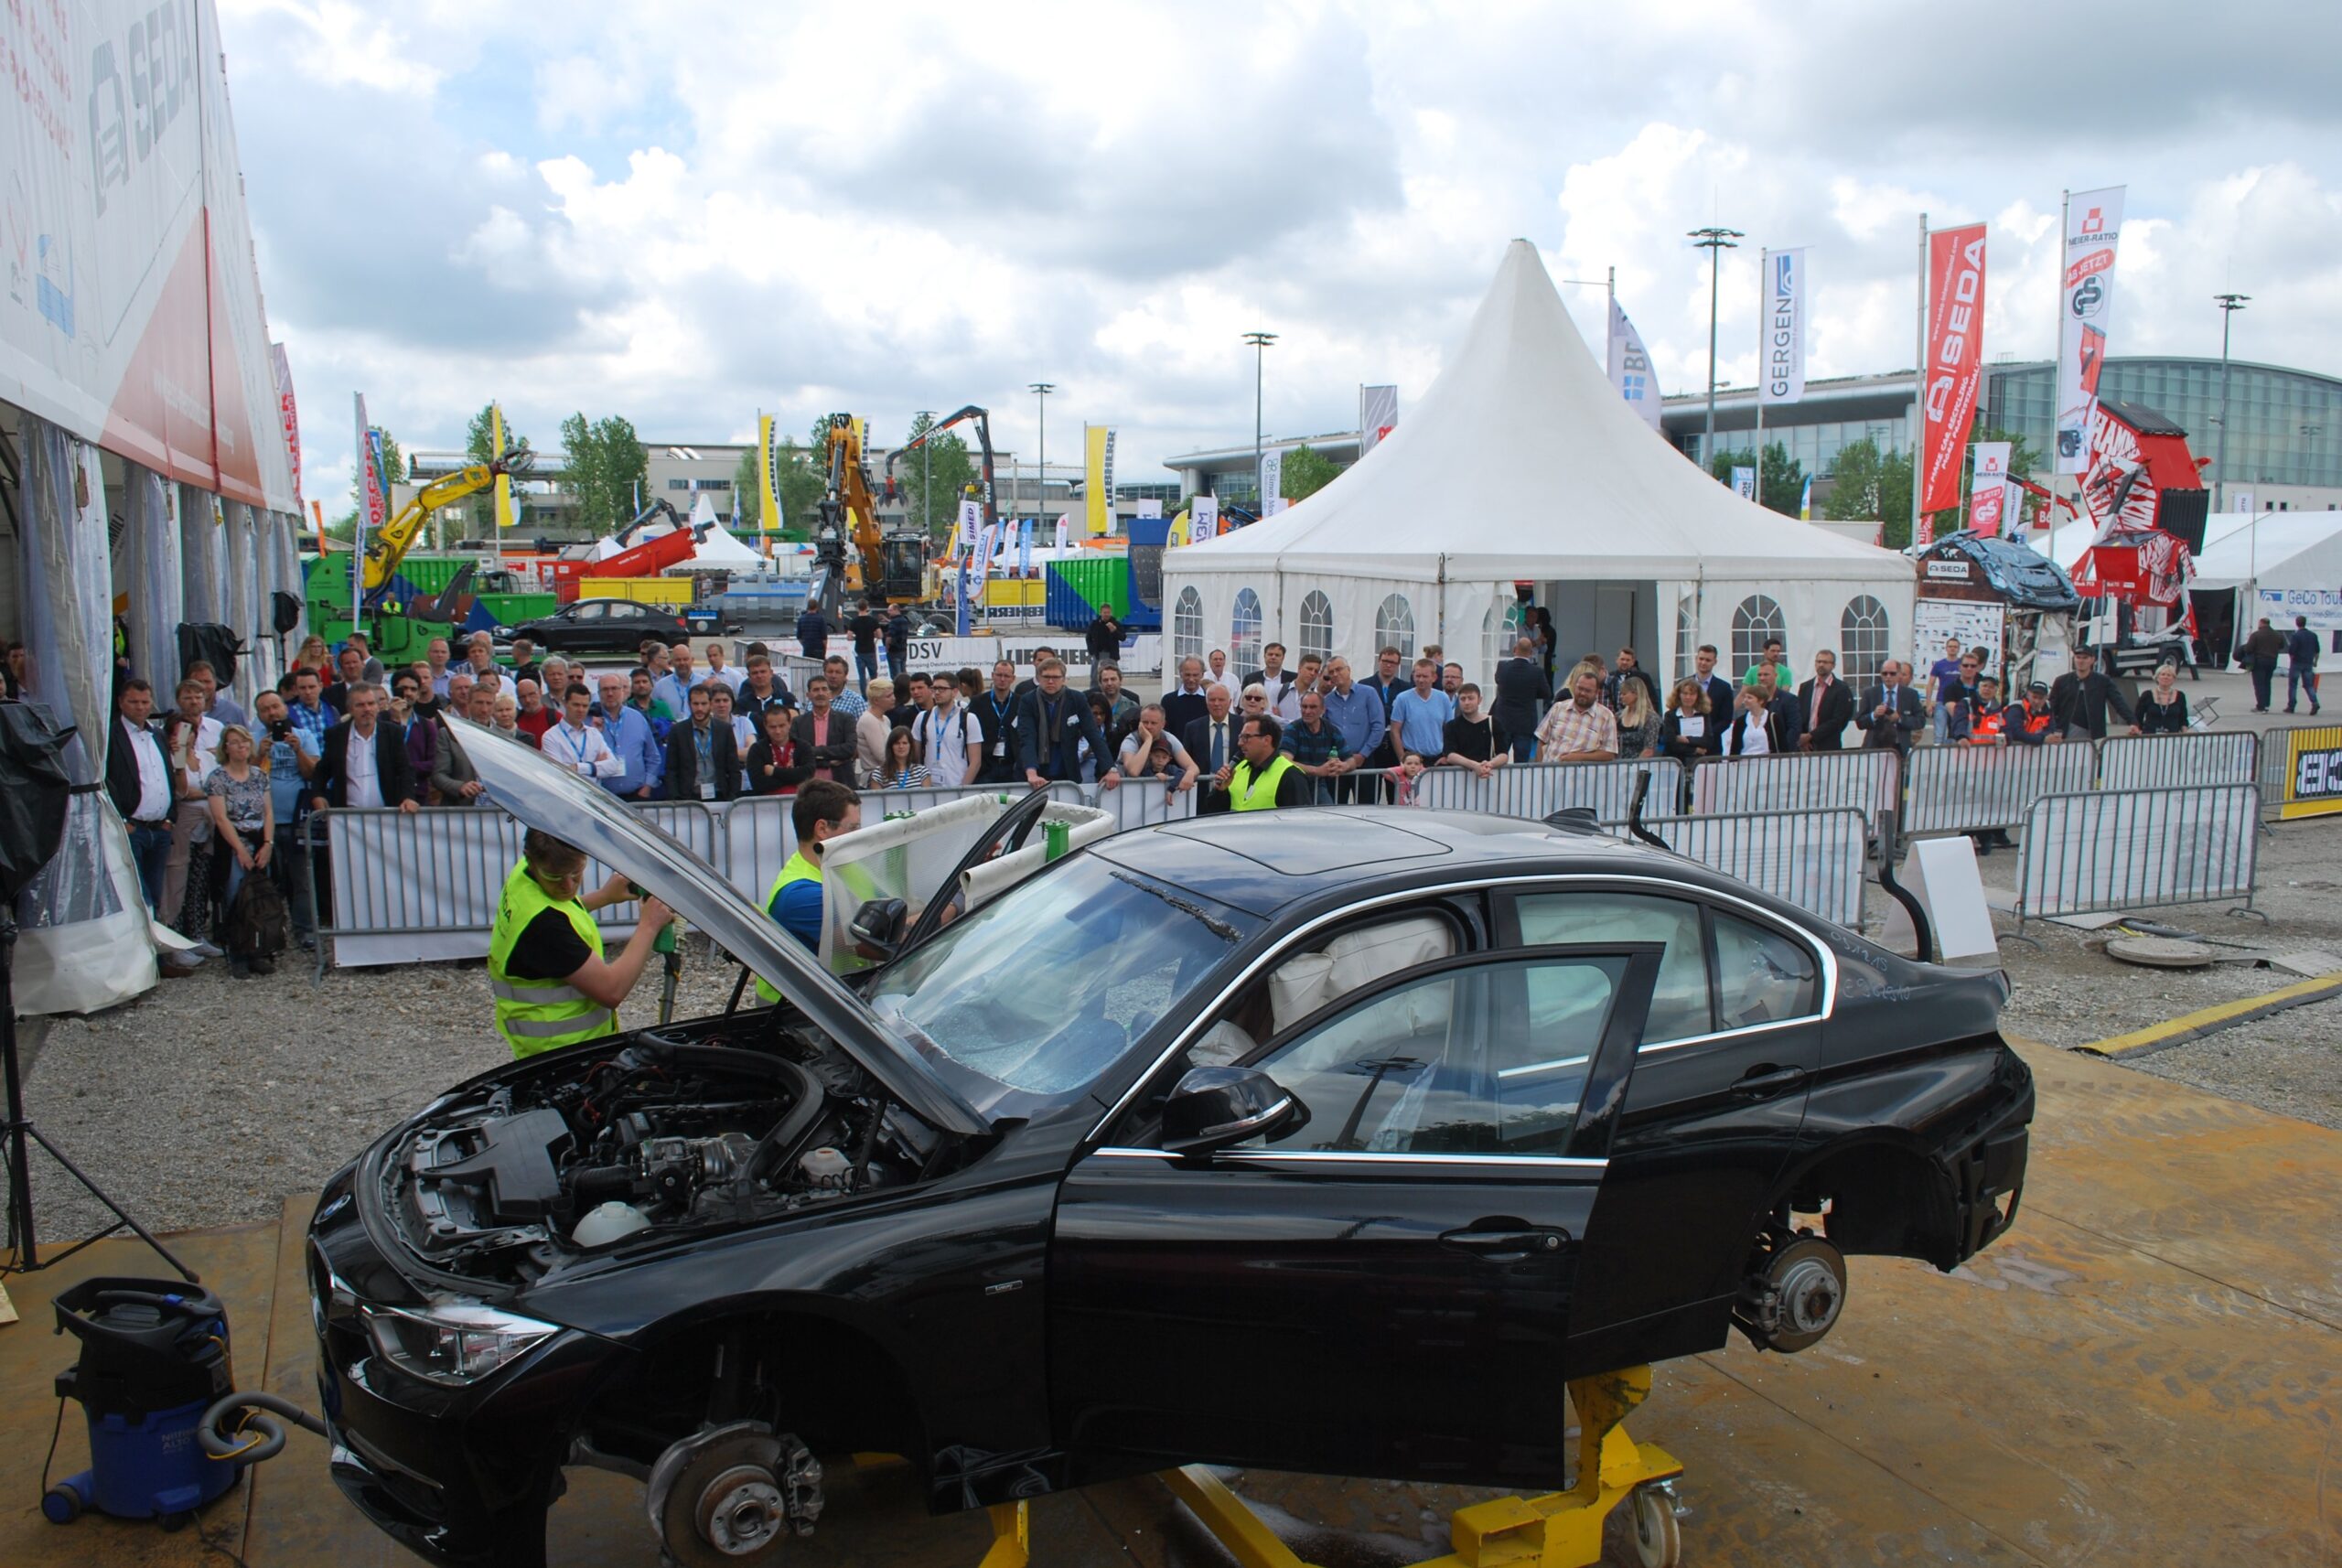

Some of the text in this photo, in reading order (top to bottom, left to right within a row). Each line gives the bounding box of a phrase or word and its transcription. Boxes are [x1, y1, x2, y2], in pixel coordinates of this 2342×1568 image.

[128, 0, 195, 164] SEDA
[1940, 237, 1985, 366] SEDA
[1771, 298, 1792, 396] GERGEN
[1104, 431, 1117, 508] LIEBHERR
[1940, 564, 1967, 573] SEDA
[2288, 590, 2316, 605] GeCo
[907, 642, 942, 660] DSV
